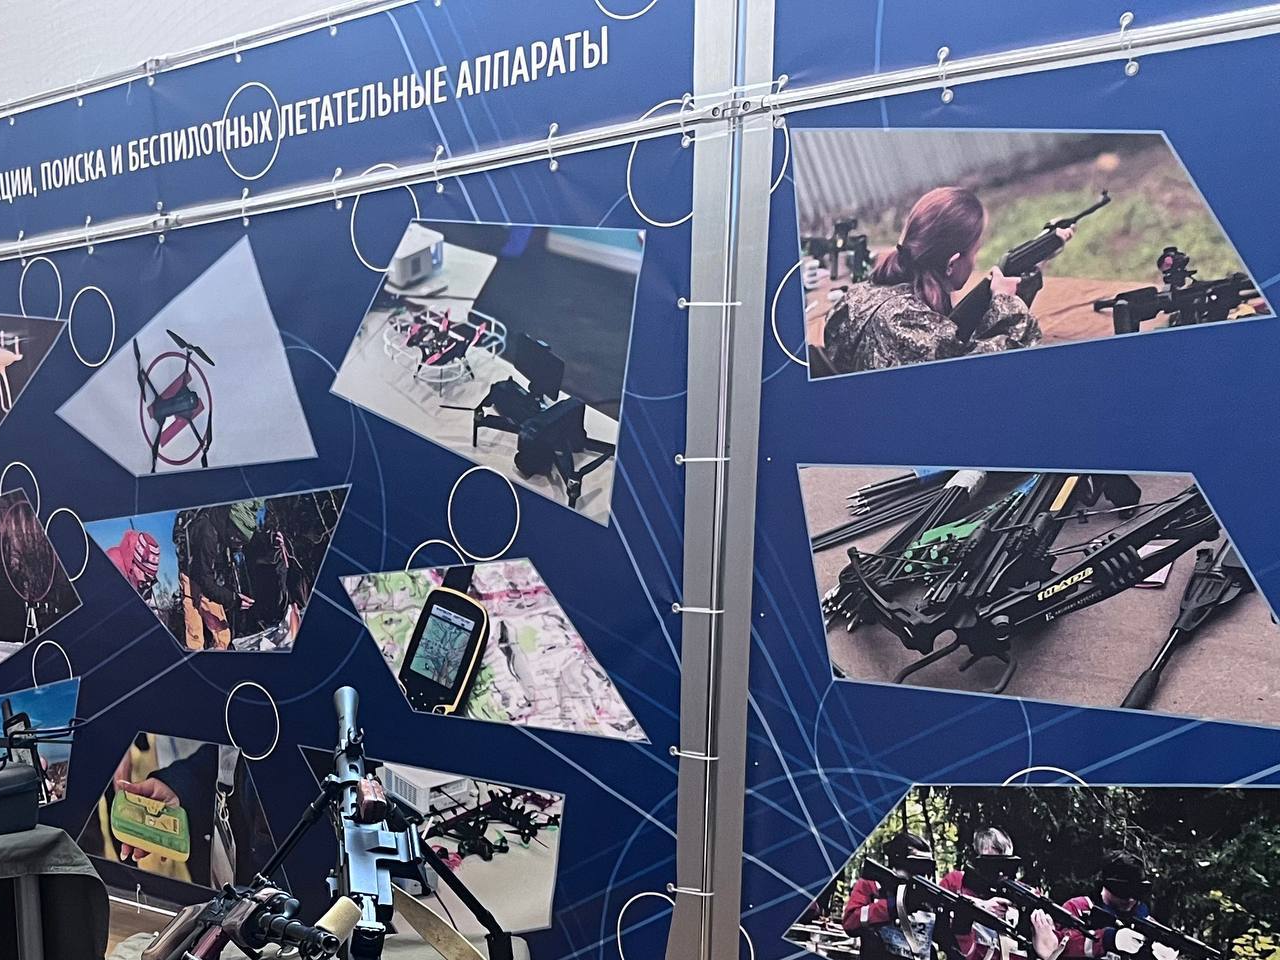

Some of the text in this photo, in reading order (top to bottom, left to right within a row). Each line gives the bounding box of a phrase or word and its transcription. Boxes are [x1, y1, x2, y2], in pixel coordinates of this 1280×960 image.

[41, 153, 106, 191] ПОИСКА
[111, 146, 124, 174] И
[127, 109, 273, 170] БЕСПИЛОТНЫХ
[280, 66, 448, 136] ЛЕТАТЕЛЬНЫЕ
[456, 26, 608, 99] АППАРАТЫ
